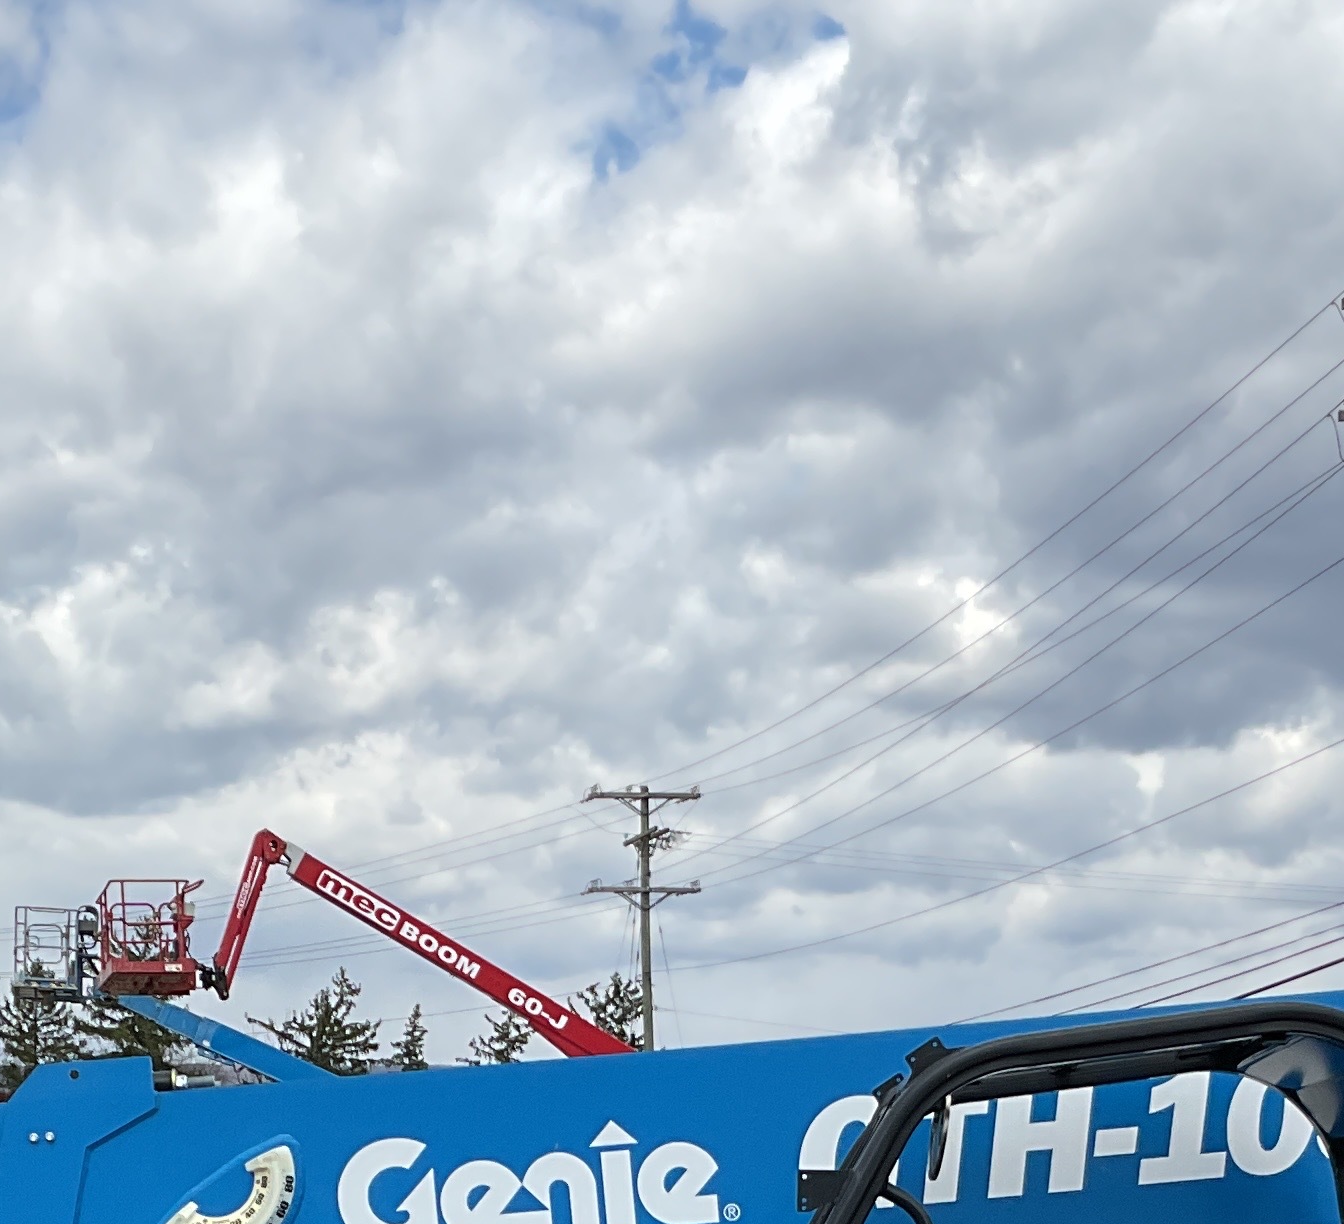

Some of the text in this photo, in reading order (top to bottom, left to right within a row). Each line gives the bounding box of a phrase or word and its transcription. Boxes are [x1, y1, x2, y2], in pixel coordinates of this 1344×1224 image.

[318, 871, 398, 928] mec
[398, 920, 482, 980] BOOM
[506, 986, 570, 1031] 60-J
[275, 1200, 290, 1219] 60
[284, 1175, 295, 1193] 80
